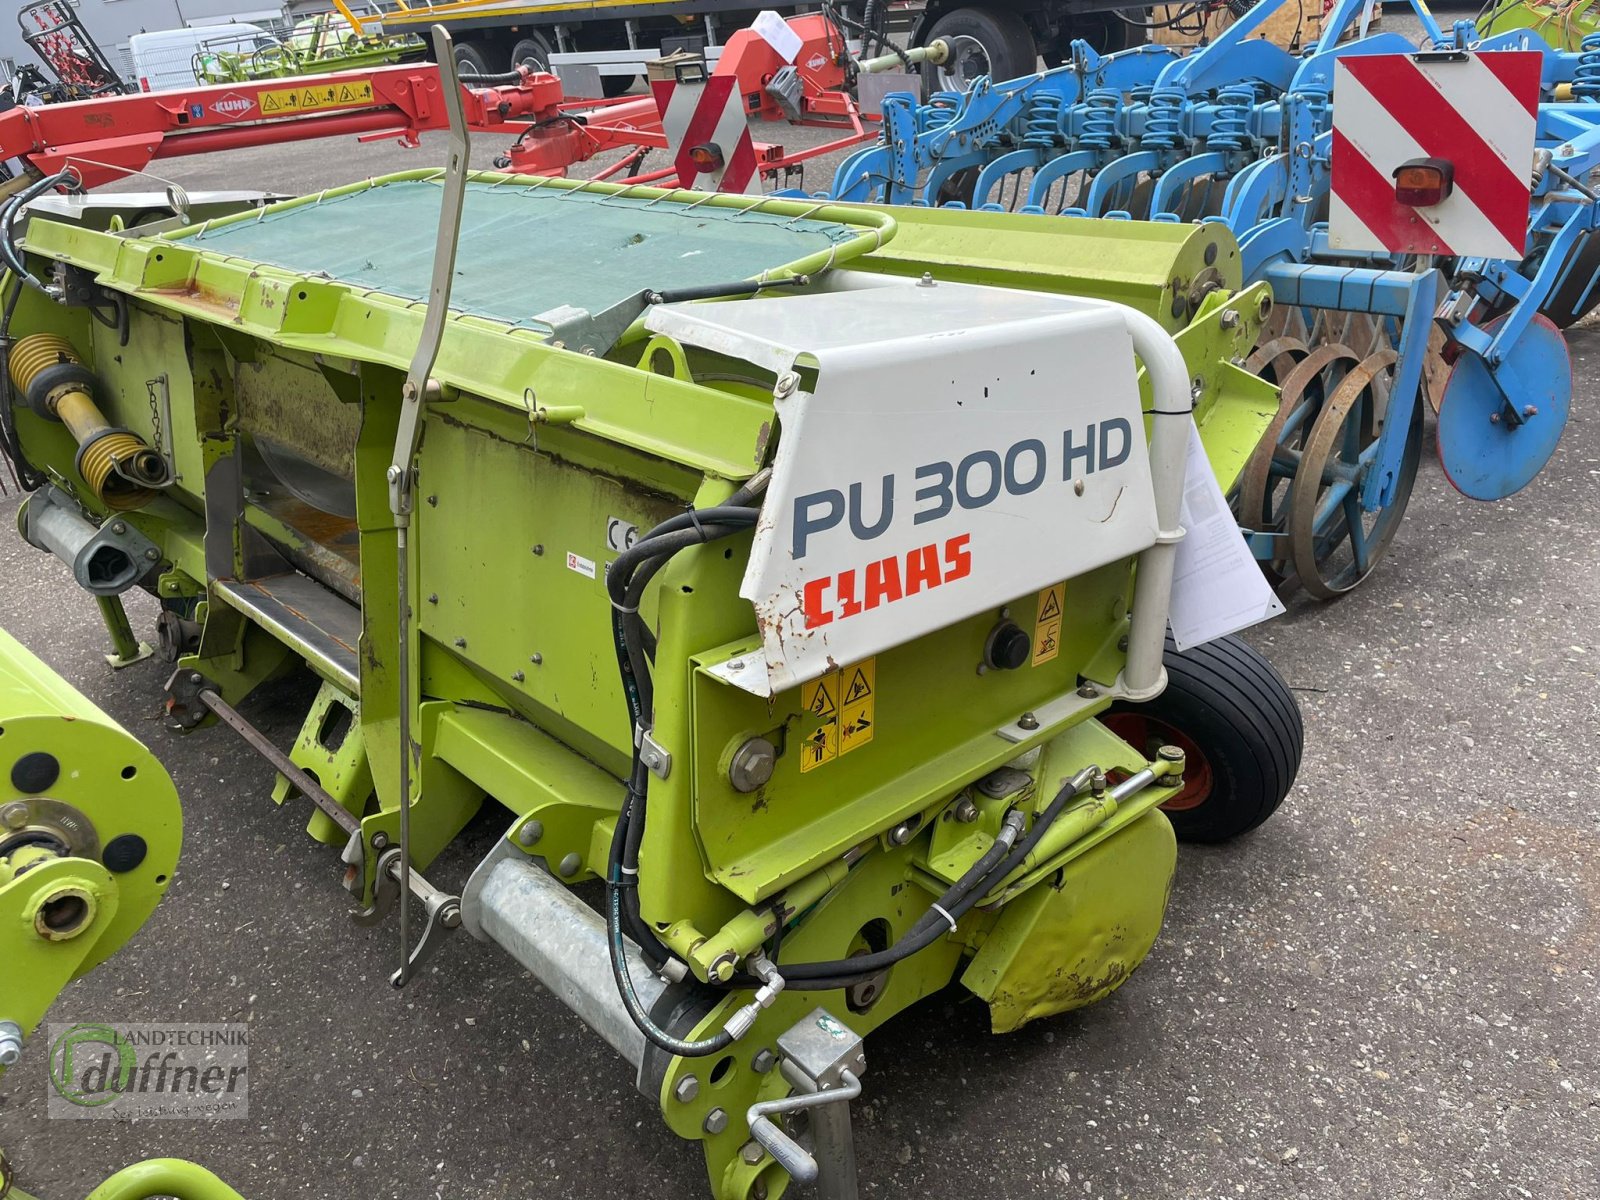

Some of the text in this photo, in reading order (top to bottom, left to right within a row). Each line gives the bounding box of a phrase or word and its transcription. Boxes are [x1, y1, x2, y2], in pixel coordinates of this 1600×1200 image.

[215, 99, 251, 112] KUHN
[792, 417, 1132, 561] PU 300 HD
[804, 532, 972, 631] CLAAS
